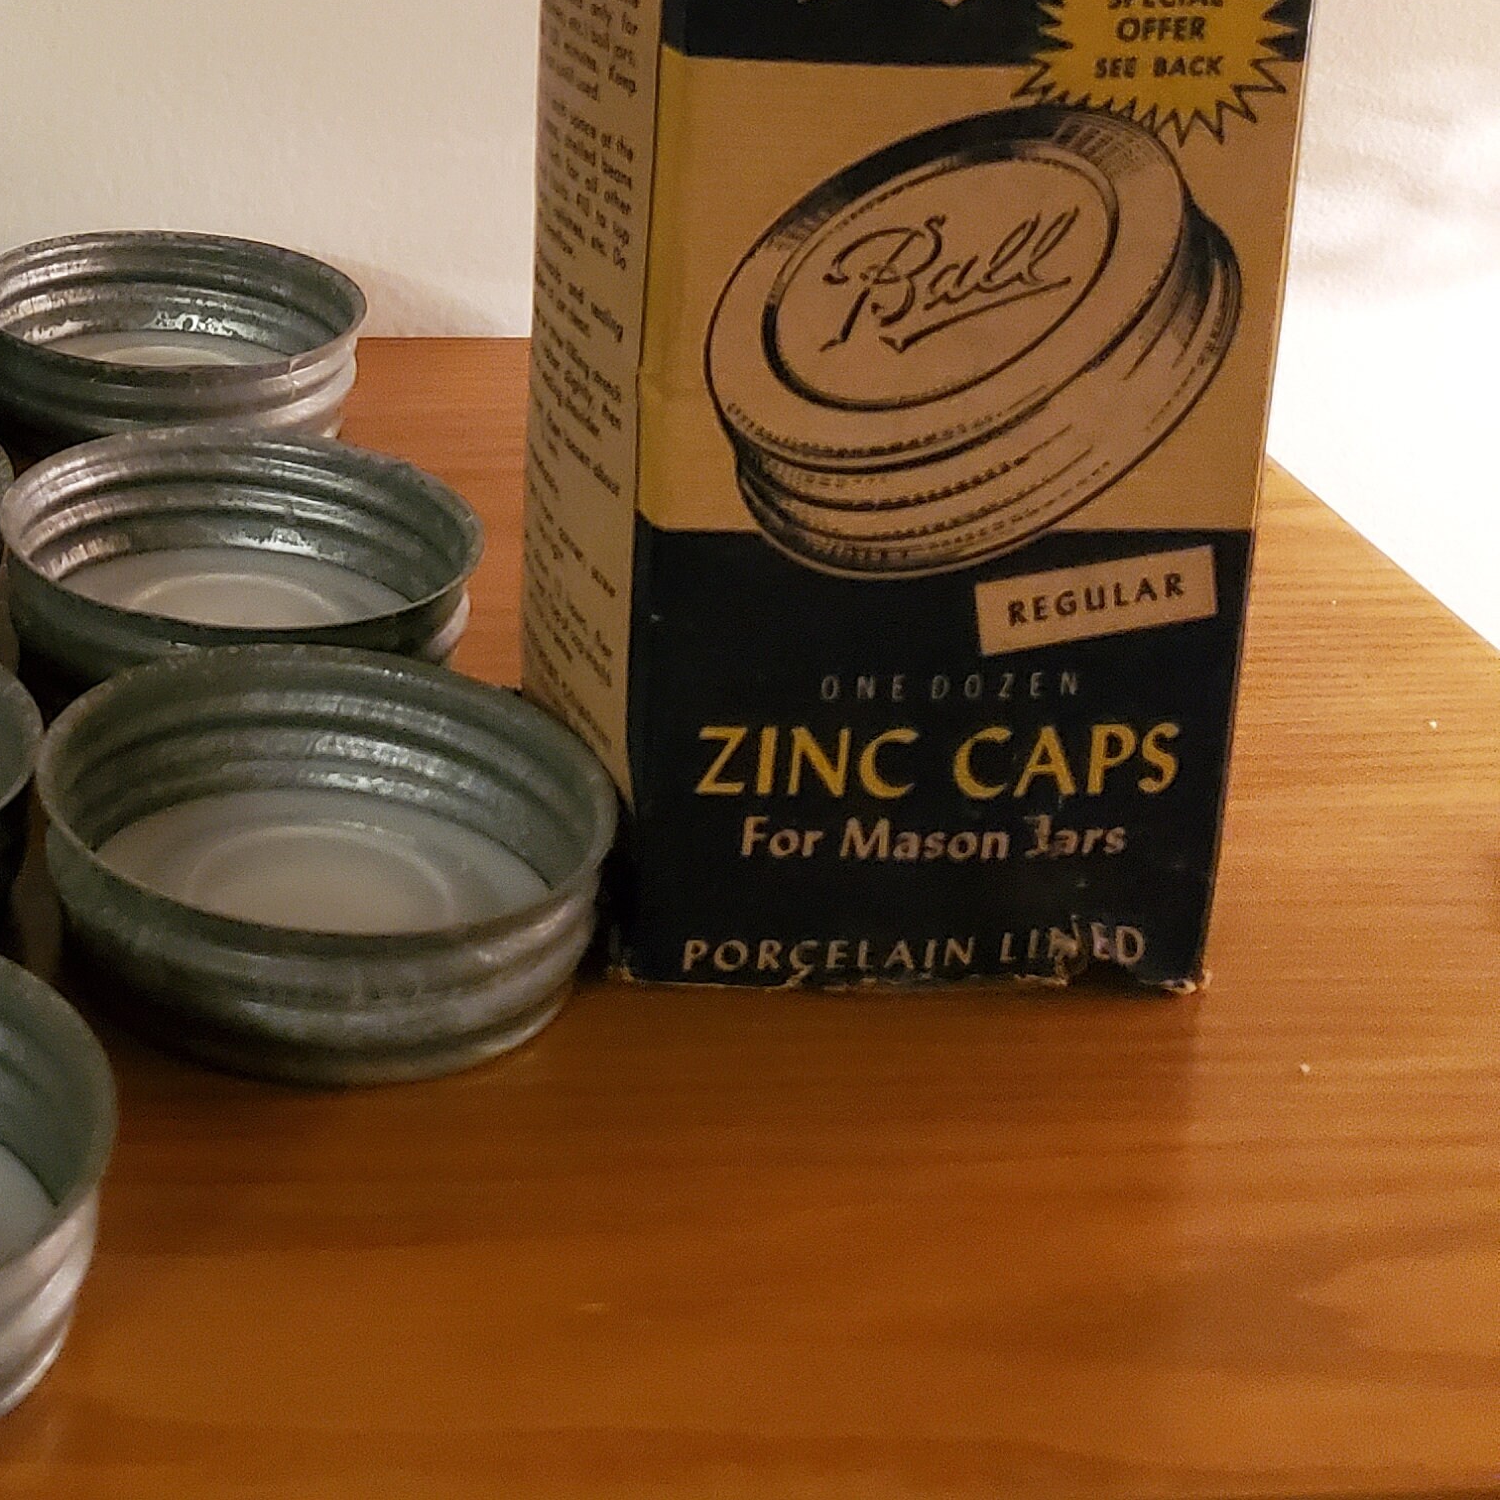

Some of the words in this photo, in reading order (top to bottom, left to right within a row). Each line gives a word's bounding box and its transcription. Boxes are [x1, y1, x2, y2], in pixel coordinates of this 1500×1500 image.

[1116, 15, 1207, 43] OFFER
[1094, 55, 1138, 80] SEE
[1152, 55, 1224, 78] BACK
[820, 206, 1080, 353] Ball
[1007, 573, 1187, 628] REGULAR
[820, 673, 905, 702] ONE
[930, 670, 1080, 700] DOZEN
[695, 726, 920, 798] ZINC
[953, 723, 1180, 800] CAPS
[741, 816, 823, 858] For
[839, 818, 1011, 861] Mason
[1025, 813, 1127, 858] Jars
[683, 936, 976, 972] PORCELAIN
[999, 915, 1145, 965] LINED
